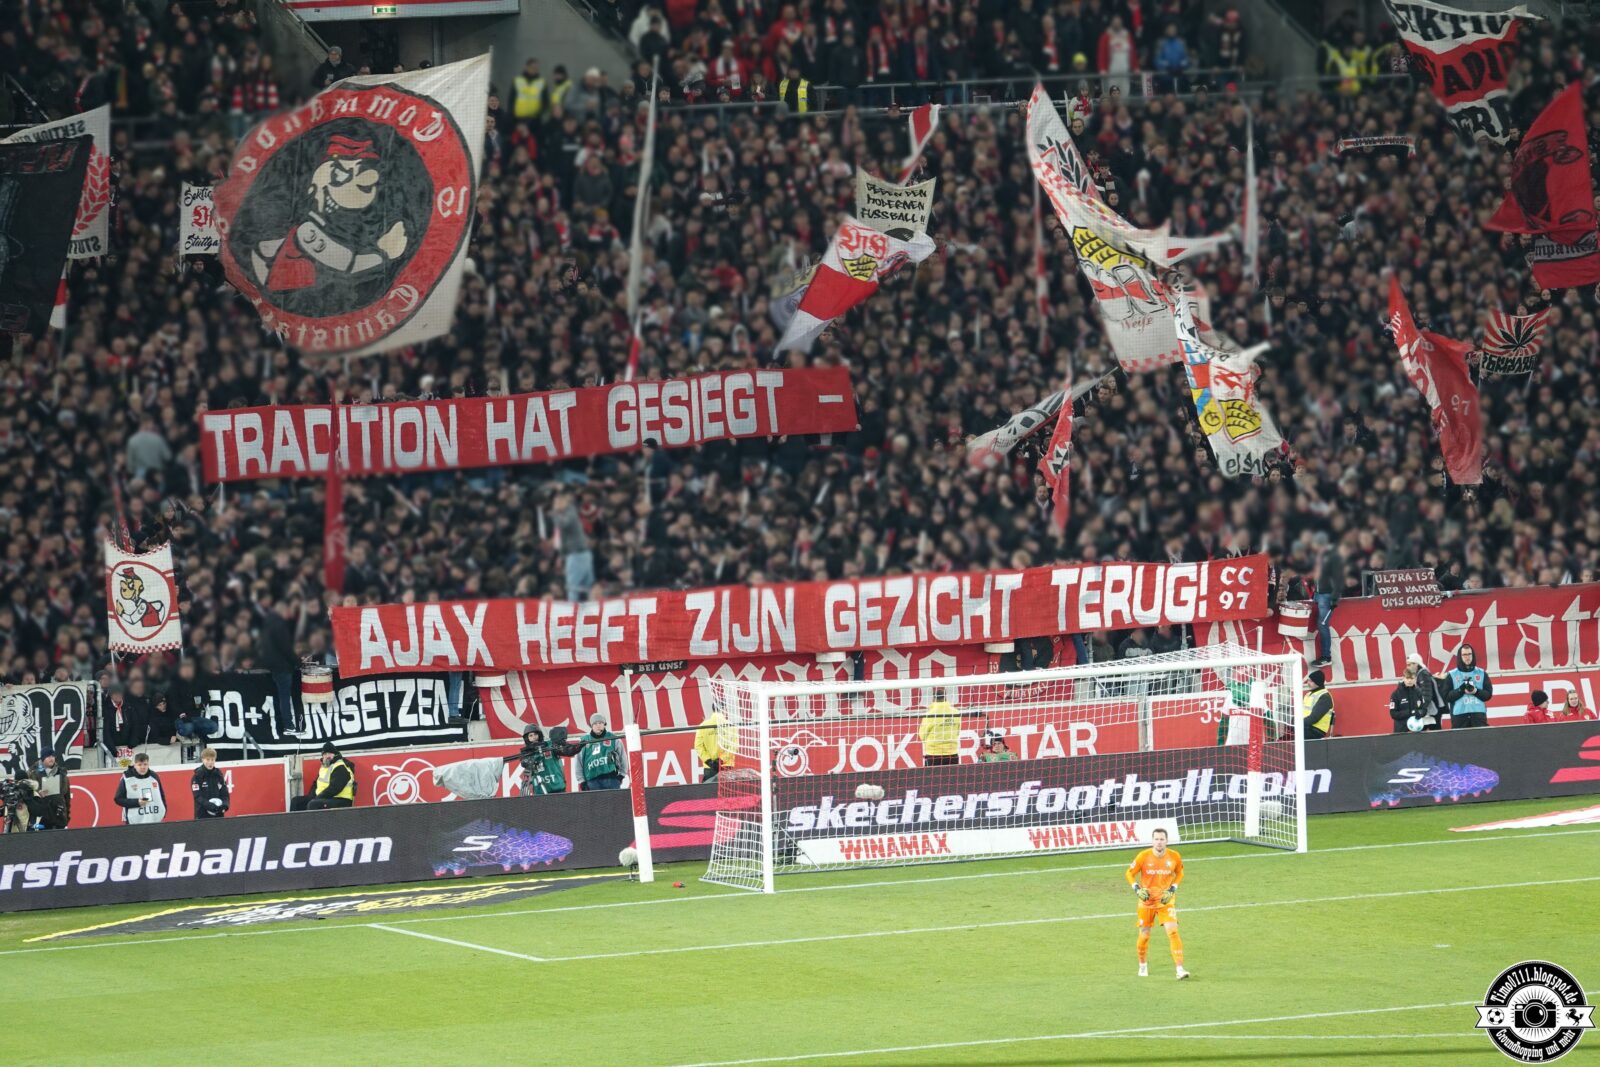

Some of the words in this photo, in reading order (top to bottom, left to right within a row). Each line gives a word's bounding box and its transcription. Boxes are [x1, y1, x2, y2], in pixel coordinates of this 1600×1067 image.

[905, 188, 927, 198] DEN
[866, 194, 925, 211] MODERNEN
[860, 207, 919, 223] FUSSBALL
[203, 402, 459, 479] TRADITION
[484, 390, 577, 462] HAT
[606, 371, 784, 448] GESIEGT
[1219, 566, 1255, 586] CC
[1375, 572, 1413, 583] ULTRA
[1416, 571, 1435, 581] IST
[1378, 586, 1401, 595] DER
[1219, 590, 1250, 610] 97
[1381, 597, 1404, 607] UMS
[1406, 594, 1442, 606] GANZE
[360, 602, 494, 670] AJAX
[515, 597, 658, 665] HEEFT
[685, 586, 797, 656] ZIJN
[824, 572, 1024, 648] GEZICHT
[1050, 561, 1208, 632] TERUG!
[638, 662, 656, 673] BEI
[658, 660, 684, 671] UNS!
[831, 721, 1100, 775] JOKRTAR
[587, 757, 609, 770] HOST
[787, 767, 1333, 832] skechersfootball.com
[839, 833, 952, 861] WINAMAX
[1029, 820, 1141, 850] WINAMAX
[0, 835, 392, 890] rsfootball.com
